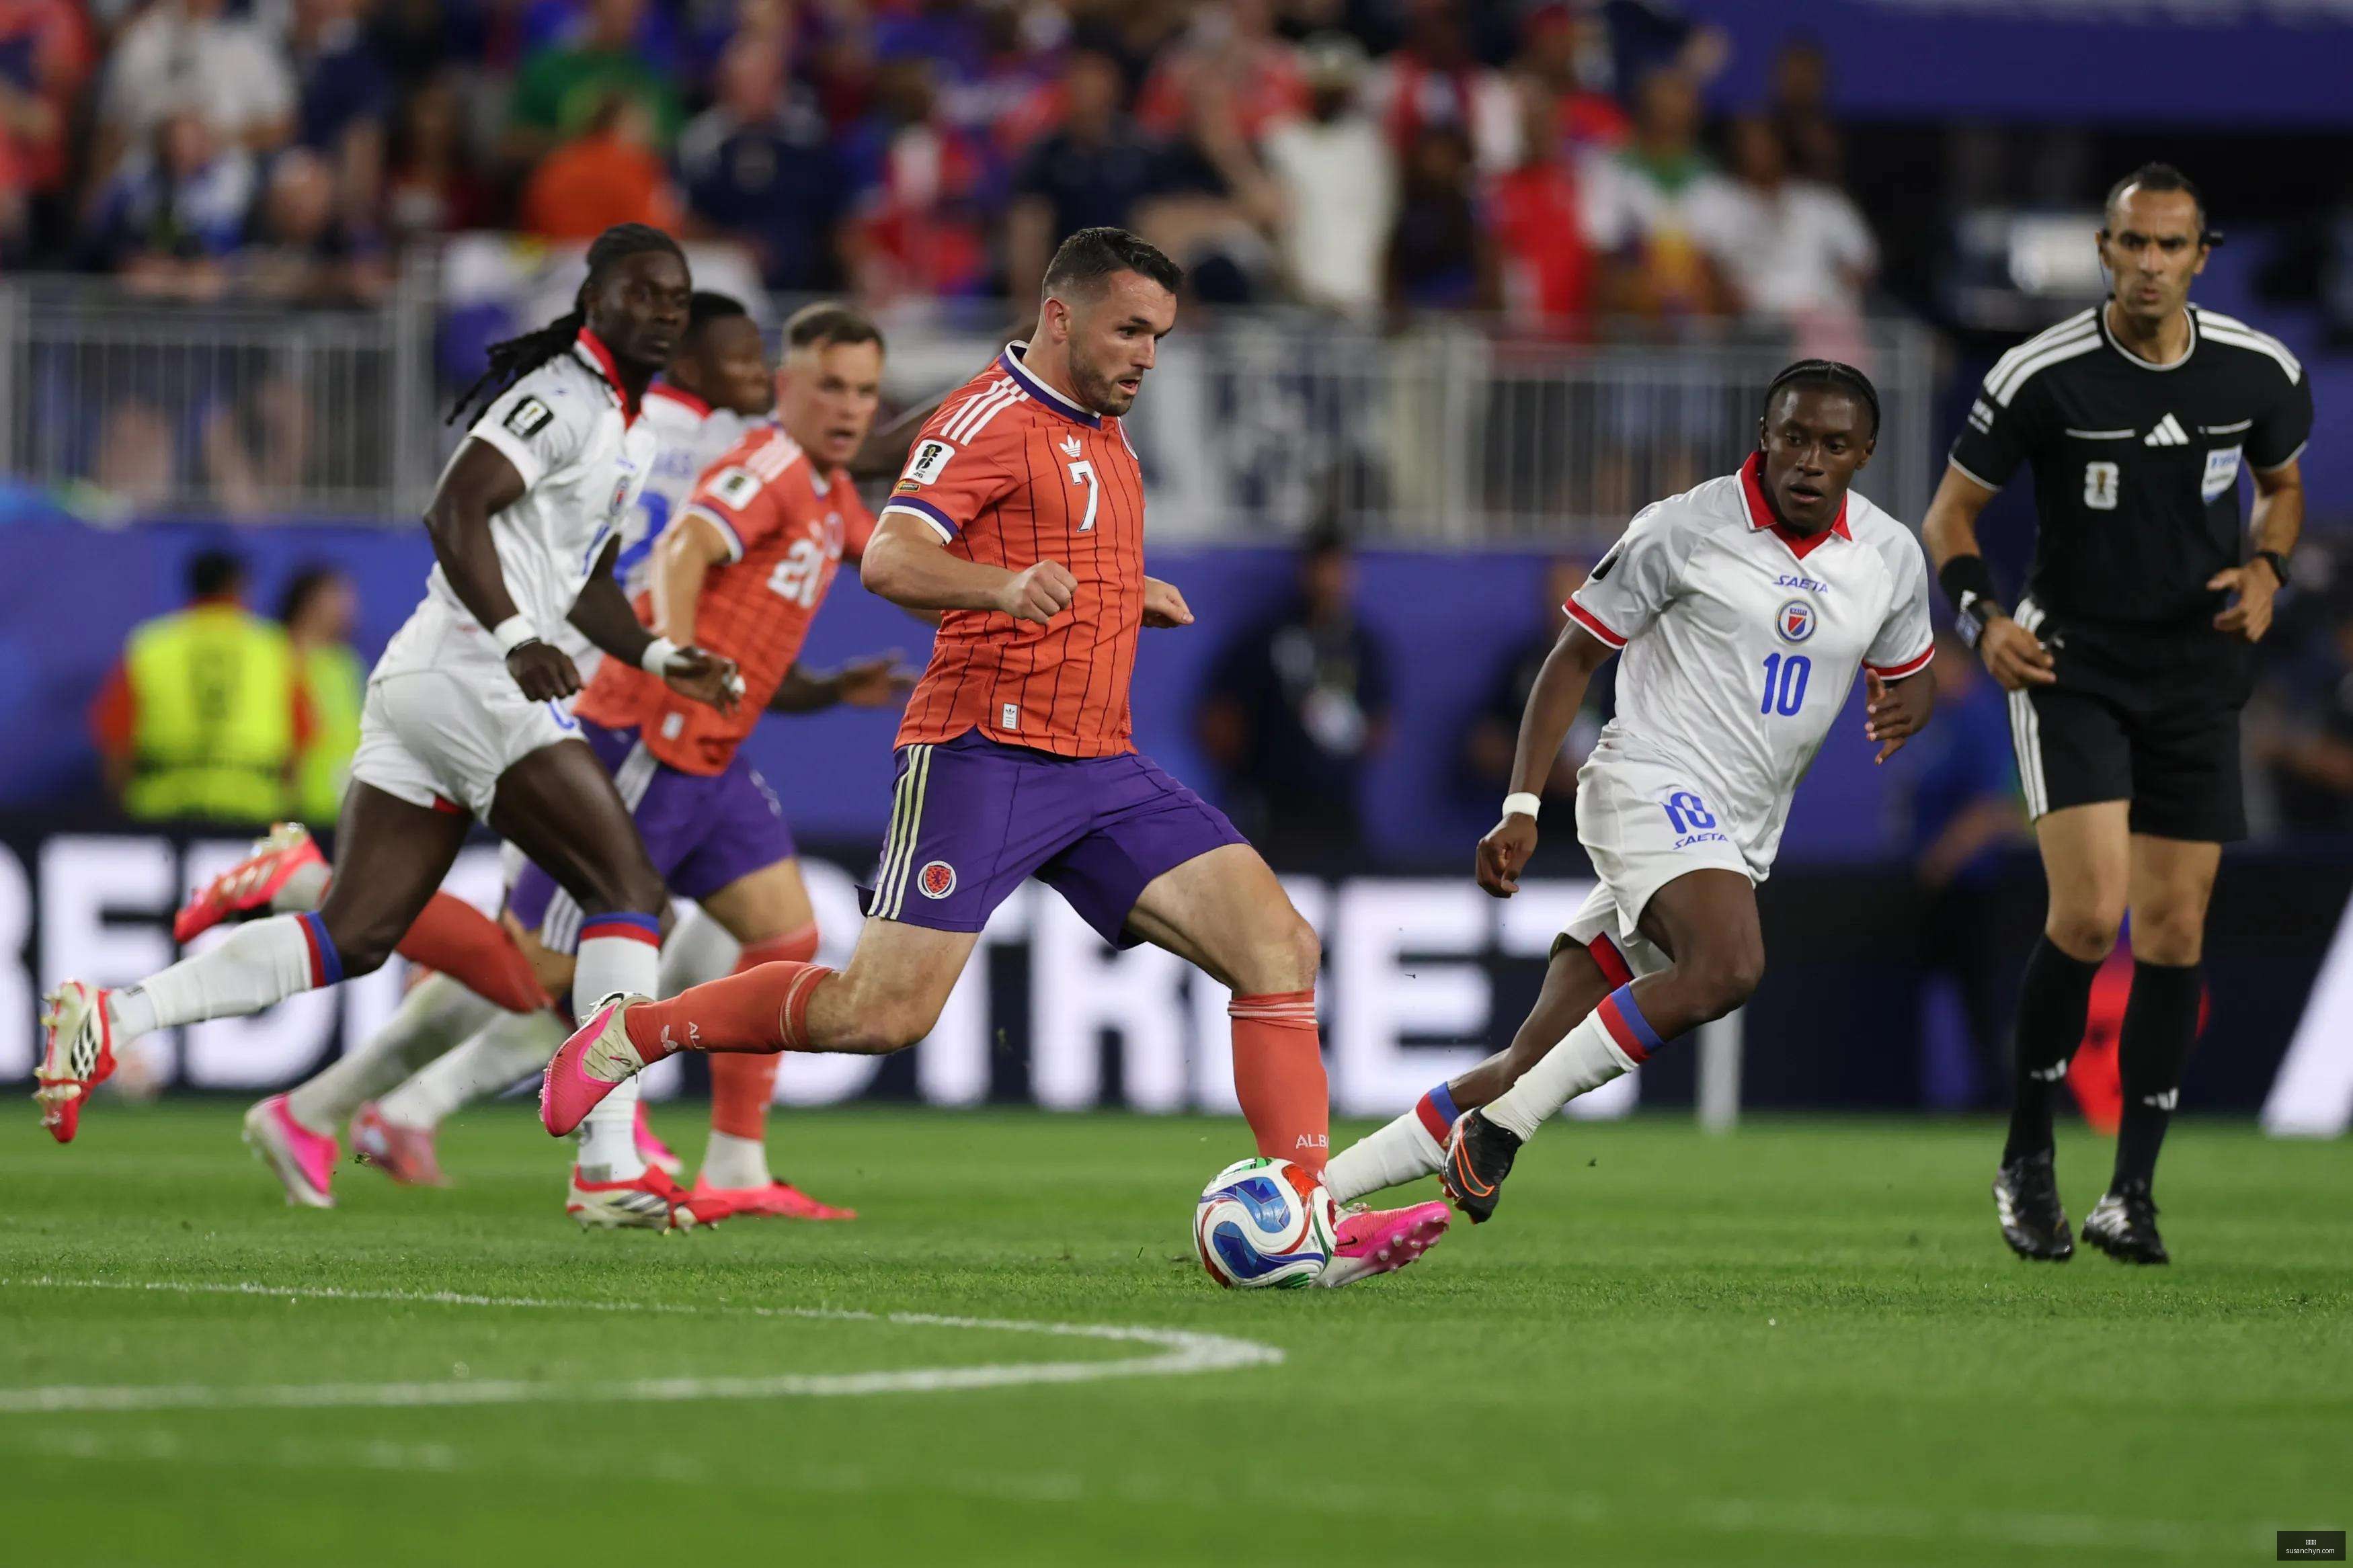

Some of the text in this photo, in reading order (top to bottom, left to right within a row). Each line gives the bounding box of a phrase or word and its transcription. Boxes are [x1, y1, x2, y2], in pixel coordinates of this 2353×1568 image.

[1068, 460, 1099, 532] 7
[1772, 575, 1829, 593] SAETA
[1761, 653, 1811, 717] 10
[1673, 833, 1730, 850] SAETA
[1295, 1133, 1329, 1149] ALB
